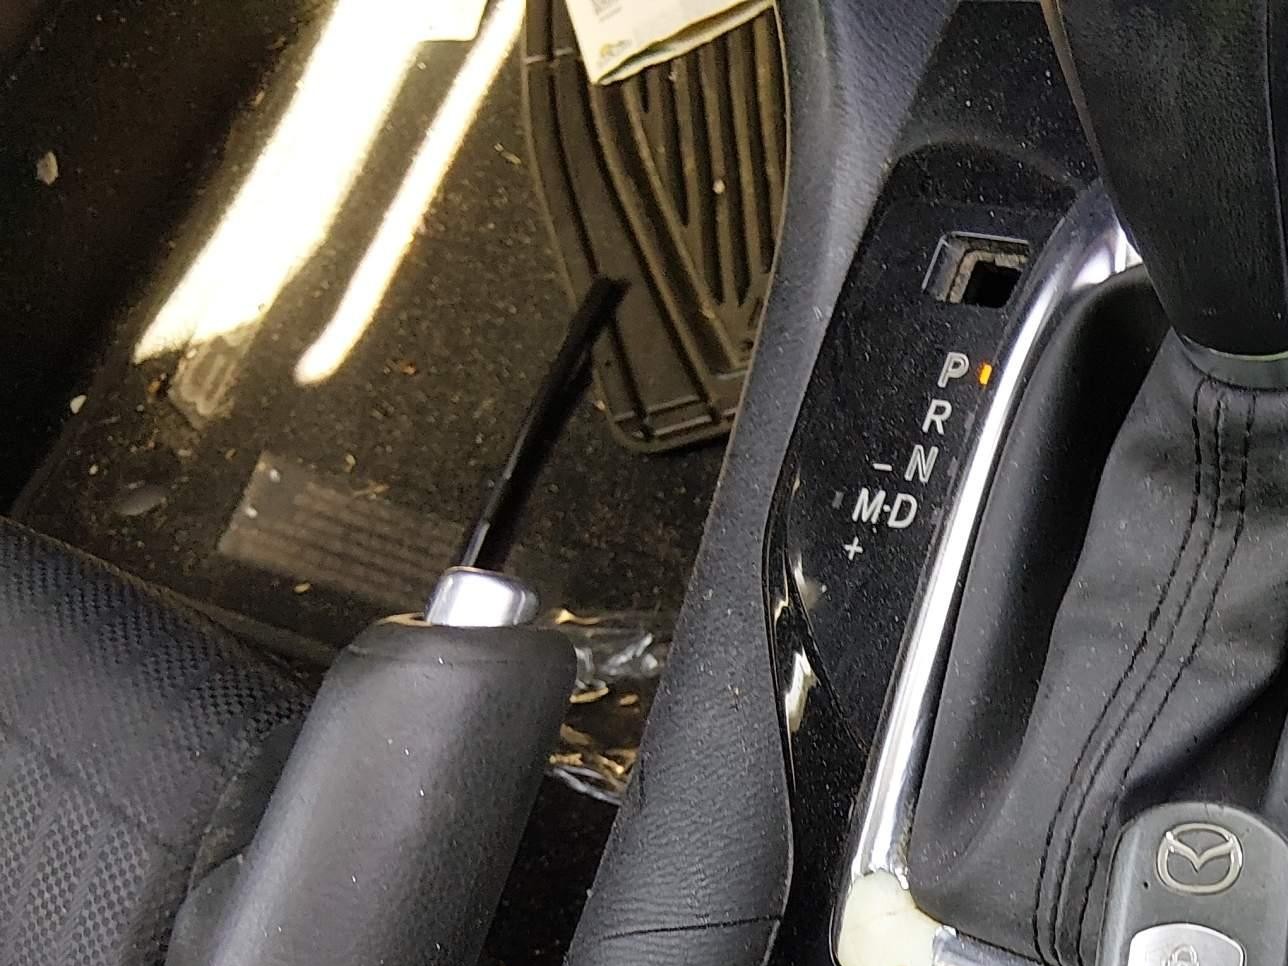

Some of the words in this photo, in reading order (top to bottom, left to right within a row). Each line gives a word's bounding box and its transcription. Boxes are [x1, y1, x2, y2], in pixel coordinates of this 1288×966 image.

[937, 351, 970, 388] P
[922, 399, 953, 435] R
[904, 444, 939, 483] N
